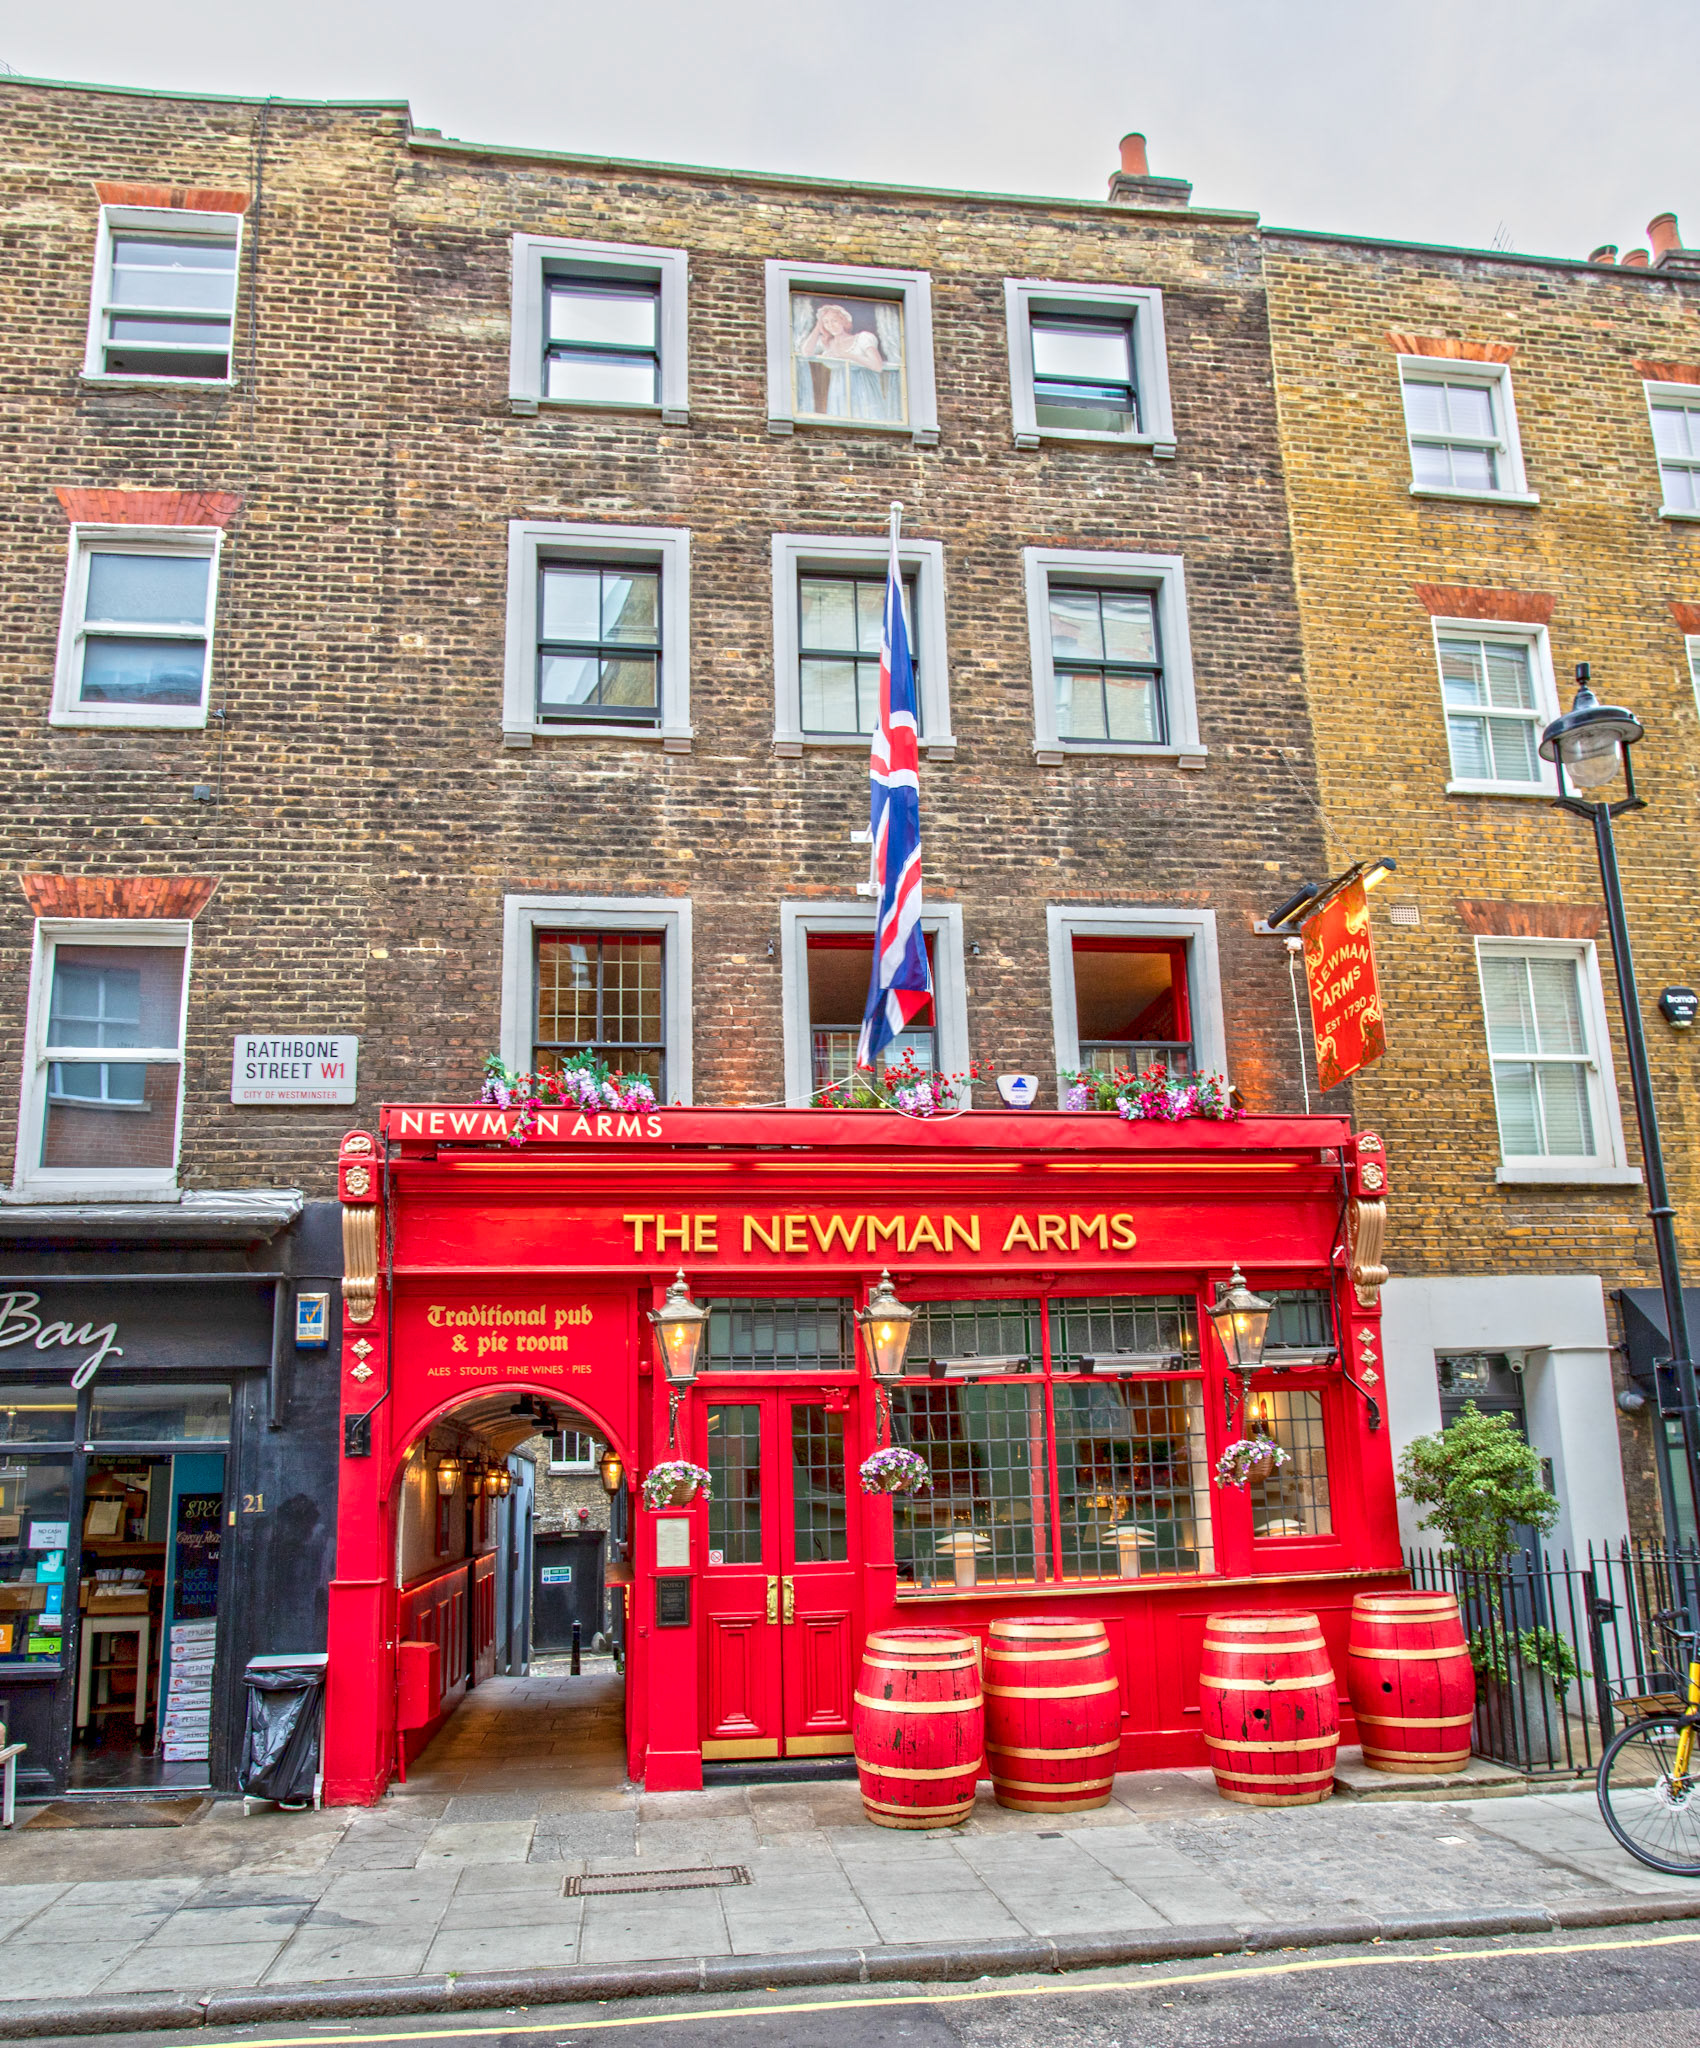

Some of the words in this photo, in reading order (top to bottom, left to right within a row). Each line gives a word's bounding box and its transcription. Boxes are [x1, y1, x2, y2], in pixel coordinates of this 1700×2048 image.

[1313, 943, 1369, 1000] NEWMAN
[1322, 965, 1361, 1012] ARMS
[1325, 1015, 1341, 1035] EST
[1343, 996, 1367, 1022] 1730
[246, 1041, 339, 1058] RATHBONE
[245, 1062, 312, 1079] STREET
[320, 1062, 345, 1079] W1
[243, 1090, 262, 1099] CITY
[265, 1090, 275, 1099] OF
[278, 1090, 337, 1099] WESTMINSTER
[400, 1111, 559, 1136] NEWMN
[571, 1114, 663, 1138] ARMS
[623, 1214, 719, 1253] THE
[743, 1214, 981, 1253] NEWMAN
[1001, 1213, 1137, 1252] ARMS
[427, 1303, 547, 1327] Traditional
[554, 1304, 594, 1331] pub
[0, 1291, 124, 1390] Bay
[451, 1333, 469, 1353] &
[477, 1330, 509, 1358] pie
[516, 1335, 569, 1352] room
[427, 1367, 451, 1377] ALES
[459, 1366, 498, 1376] STOUTS
[506, 1366, 529, 1375] FINE
[532, 1365, 564, 1375] WINES
[572, 1364, 592, 1374] PIES
[242, 1493, 266, 1513] 21
